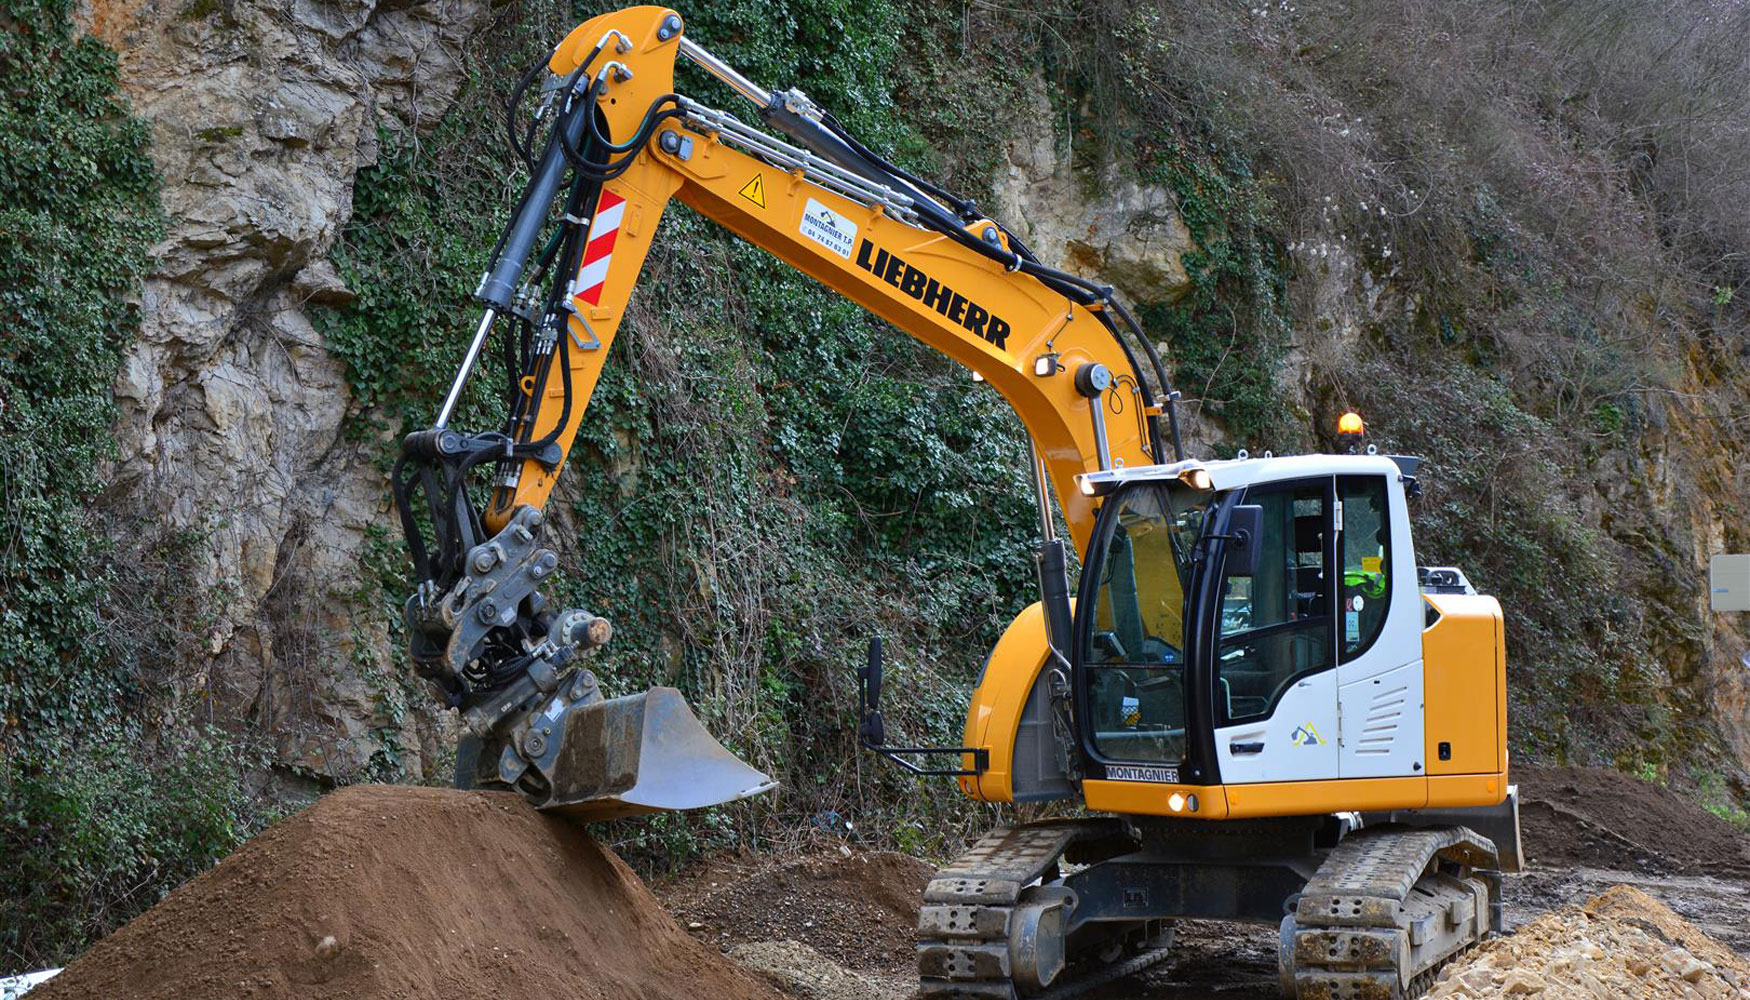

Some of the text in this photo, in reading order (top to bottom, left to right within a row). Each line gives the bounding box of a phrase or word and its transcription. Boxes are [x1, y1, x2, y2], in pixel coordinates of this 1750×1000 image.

[804, 213, 843, 240] MONTAGNIER
[807, 229, 816, 237] 04
[817, 234, 825, 242] 74
[855, 237, 1011, 352] LIEBHERR
[1106, 766, 1178, 782] MONTAGNIER
